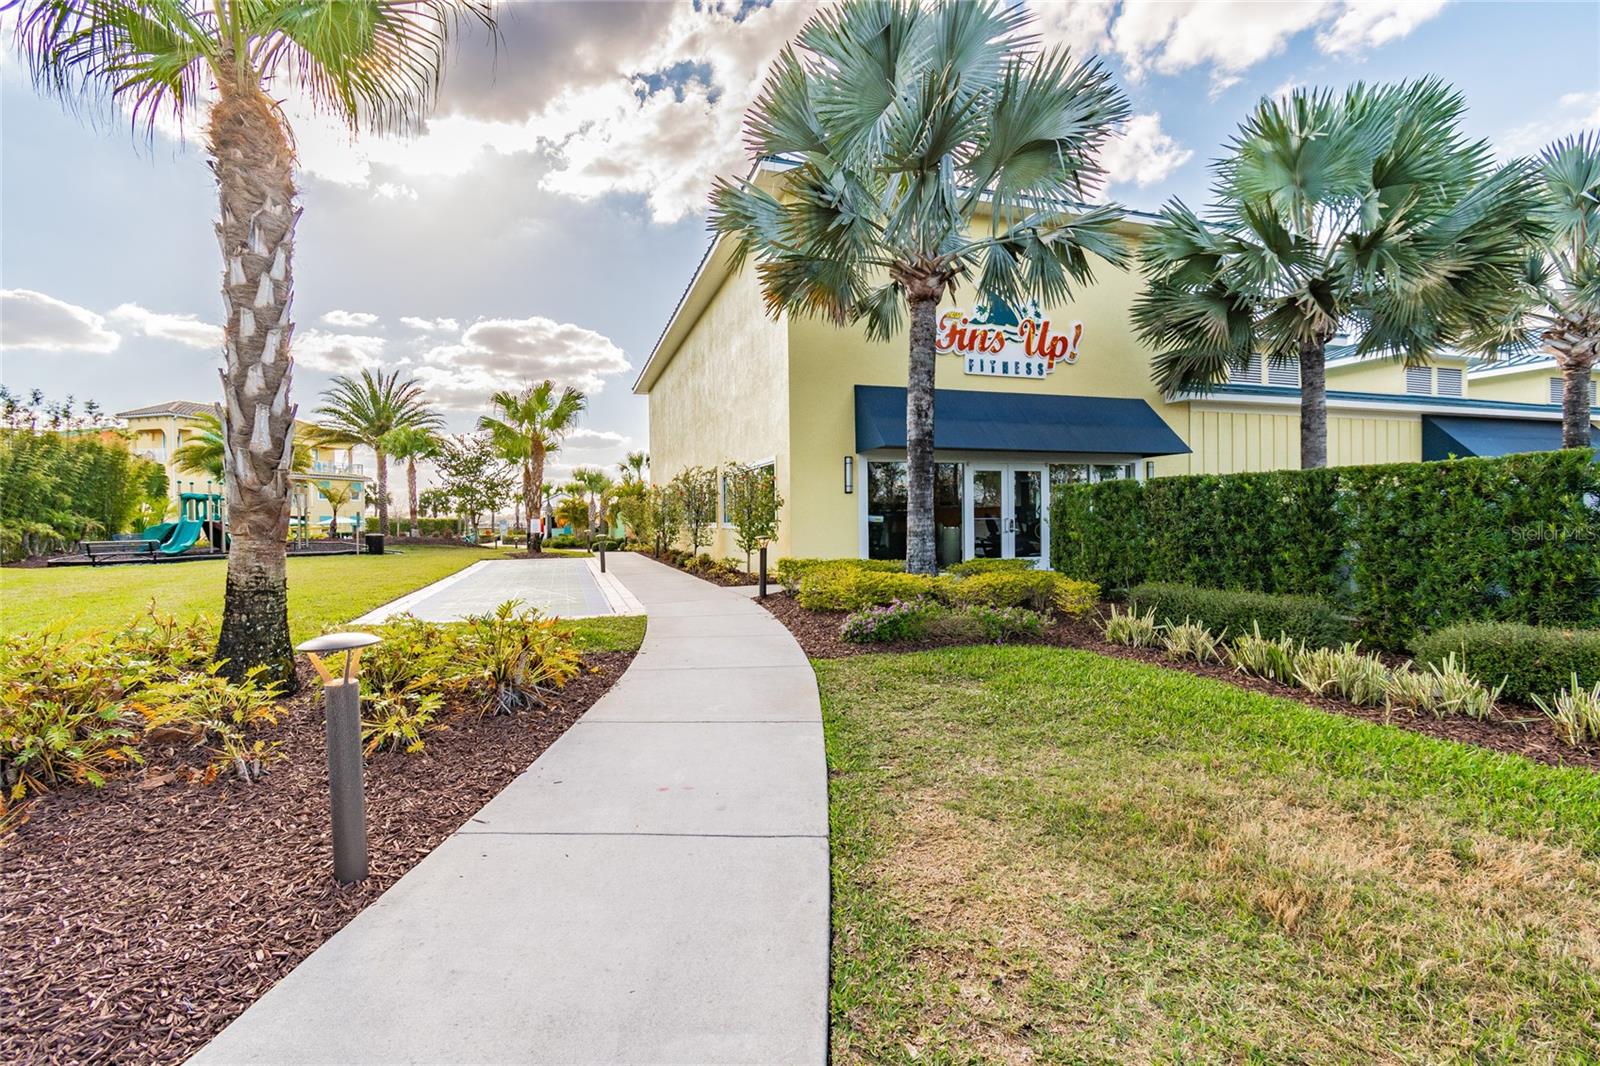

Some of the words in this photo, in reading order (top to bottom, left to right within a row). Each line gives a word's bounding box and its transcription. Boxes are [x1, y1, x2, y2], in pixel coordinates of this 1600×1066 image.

[936, 312, 1006, 353] Fins
[1019, 318, 1082, 369] Up!
[968, 358, 1045, 376] FITNESS
